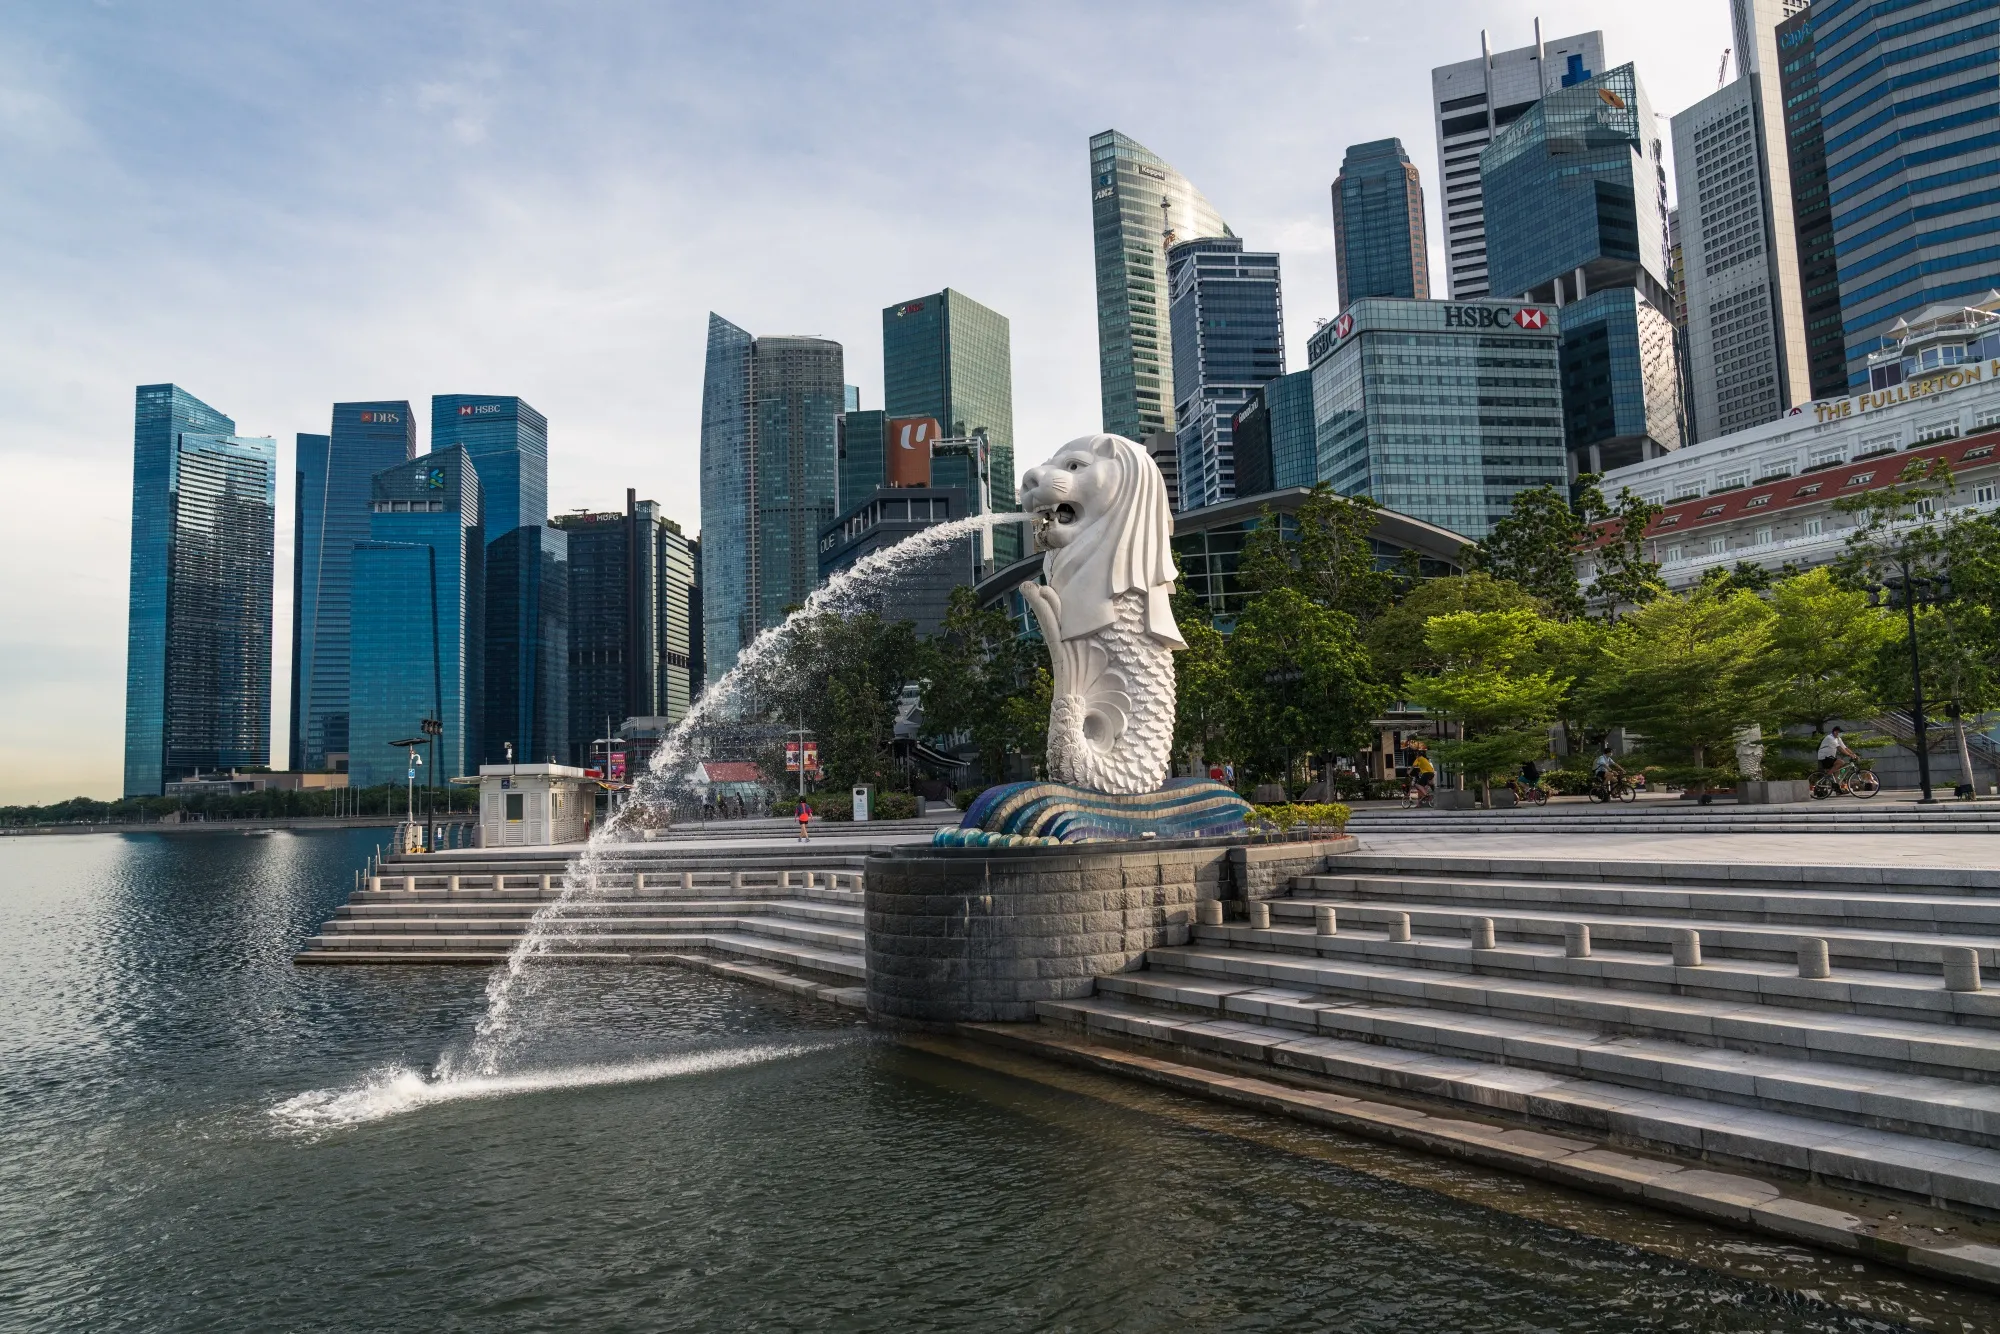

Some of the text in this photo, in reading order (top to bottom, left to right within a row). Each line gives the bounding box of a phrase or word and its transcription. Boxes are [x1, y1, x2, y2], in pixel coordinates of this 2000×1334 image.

[1596, 111, 1628, 124] MYP
[1507, 121, 1532, 144] MYP
[1095, 186, 1114, 200] ANZ
[1444, 306, 1511, 328] HSBC
[1308, 323, 1338, 364] HSBC
[1814, 403, 1851, 422] THE
[1859, 365, 1981, 412] FULLERTON
[373, 413, 399, 423] DBS
[475, 405, 500, 413] HSBC
